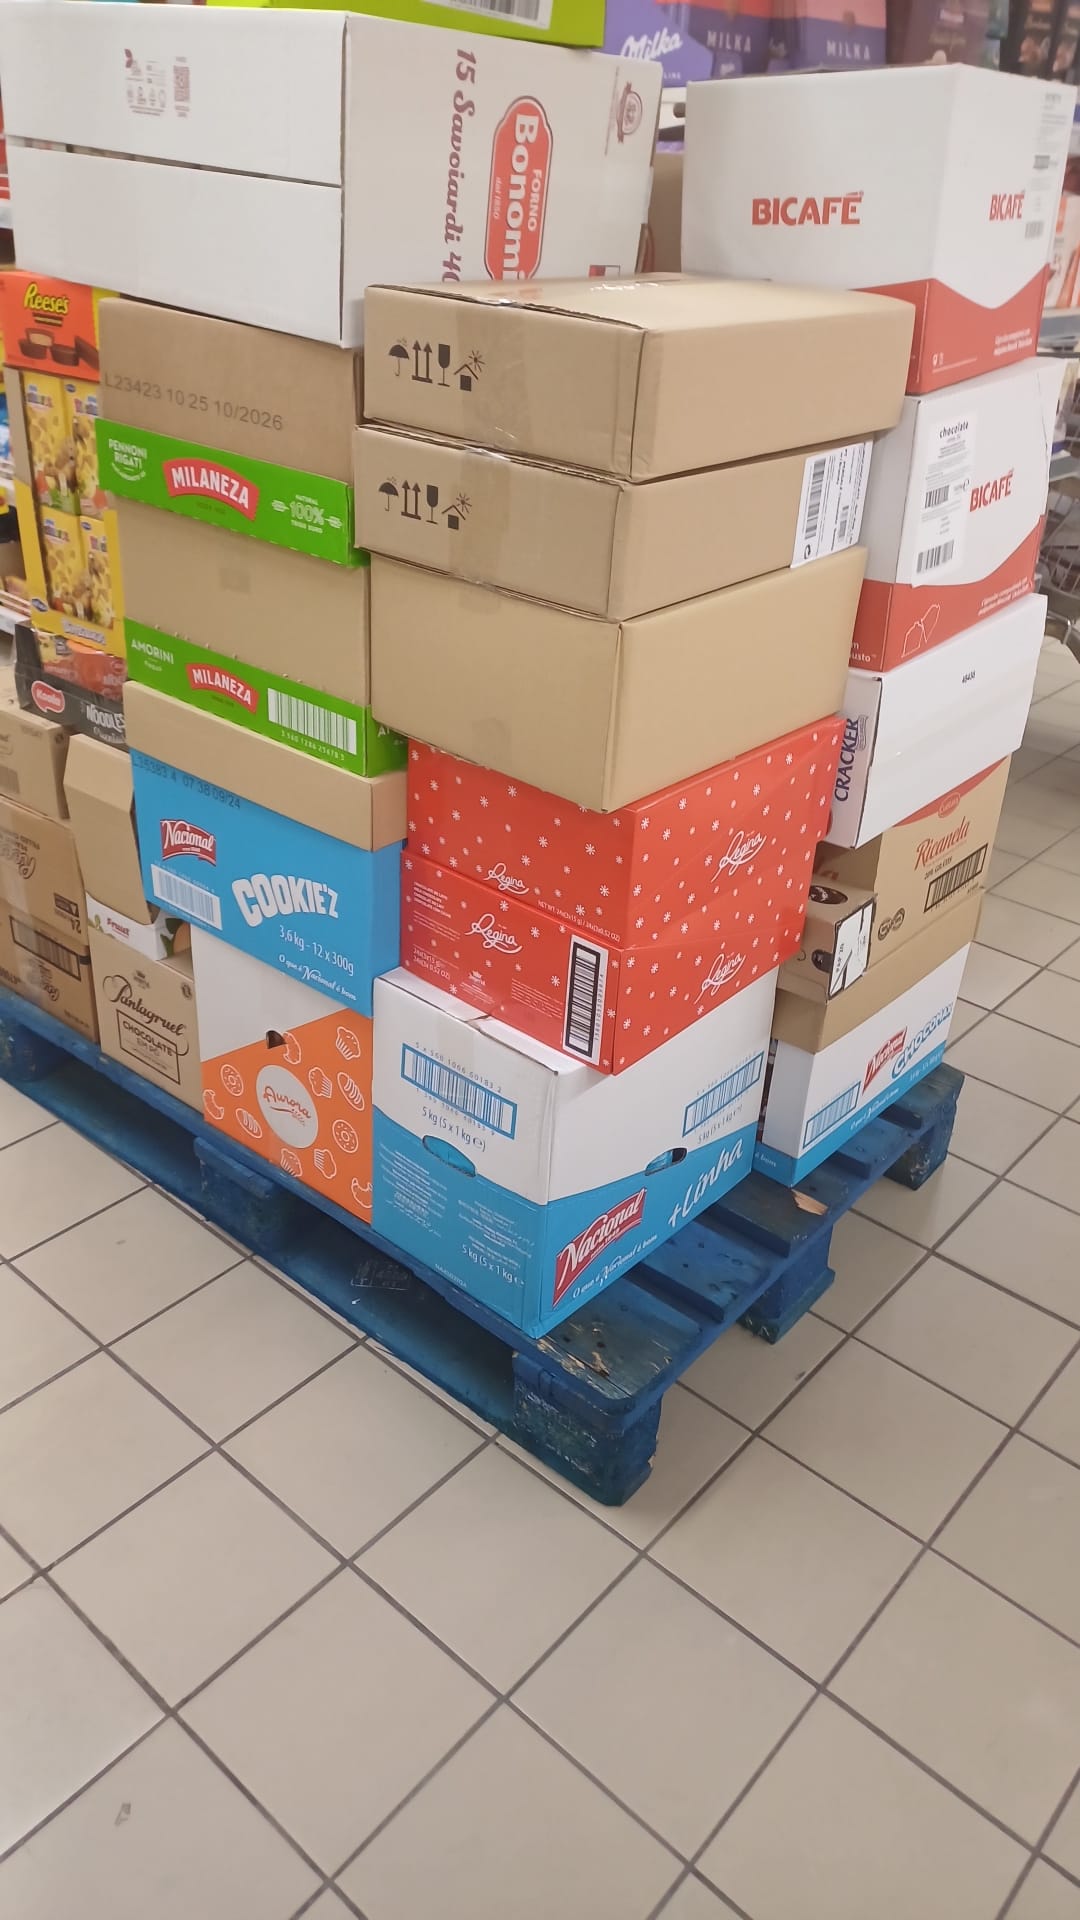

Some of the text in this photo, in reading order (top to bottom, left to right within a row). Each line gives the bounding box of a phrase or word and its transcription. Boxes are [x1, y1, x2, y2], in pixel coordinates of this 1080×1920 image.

[707, 30, 751, 53] MILKA
[826, 40, 871, 60] MILKA
[455, 49, 477, 84] 15
[444, 90, 475, 243] Savoiardi
[502, 114, 539, 281] Bonomi
[527, 168, 543, 231] FORNO
[24, 281, 70, 315] Reese's
[104, 372, 284, 431] L23423 10 25 10/2026
[940, 421, 969, 439] chocolate
[171, 466, 249, 509] MILANEZA
[289, 501, 325, 526] 100%
[131, 638, 174, 665] AMORINI
[191, 668, 252, 705] MILANEZA
[834, 717, 859, 802] CRACKER
[160, 820, 217, 852] Nacional
[914, 816, 971, 872] Ricanela
[711, 830, 768, 883] Regina
[483, 862, 530, 894] Regina
[231, 873, 339, 928] COOKIE'Z
[279, 924, 293, 943] 3,6
[294, 931, 305, 952] kg
[312, 941, 323, 958] 12
[331, 951, 354, 977] 300g
[464, 913, 523, 954] Regina
[302, 965, 337, 992] Nacional
[693, 953, 747, 1005] Regina
[103, 974, 186, 1036] Pantagruel
[122, 1020, 174, 1057] CHOCOLATE
[263, 1086, 312, 1119] Aurora
[421, 1106, 427, 1117] 5
[428, 1109, 438, 1125] kg
[439, 1118, 448, 1130] (5
[461, 1129, 471, 1145] kg
[555, 1187, 648, 1291] Nacional
[467, 1249, 478, 1264] kg
[502, 1267, 513, 1283] kg
